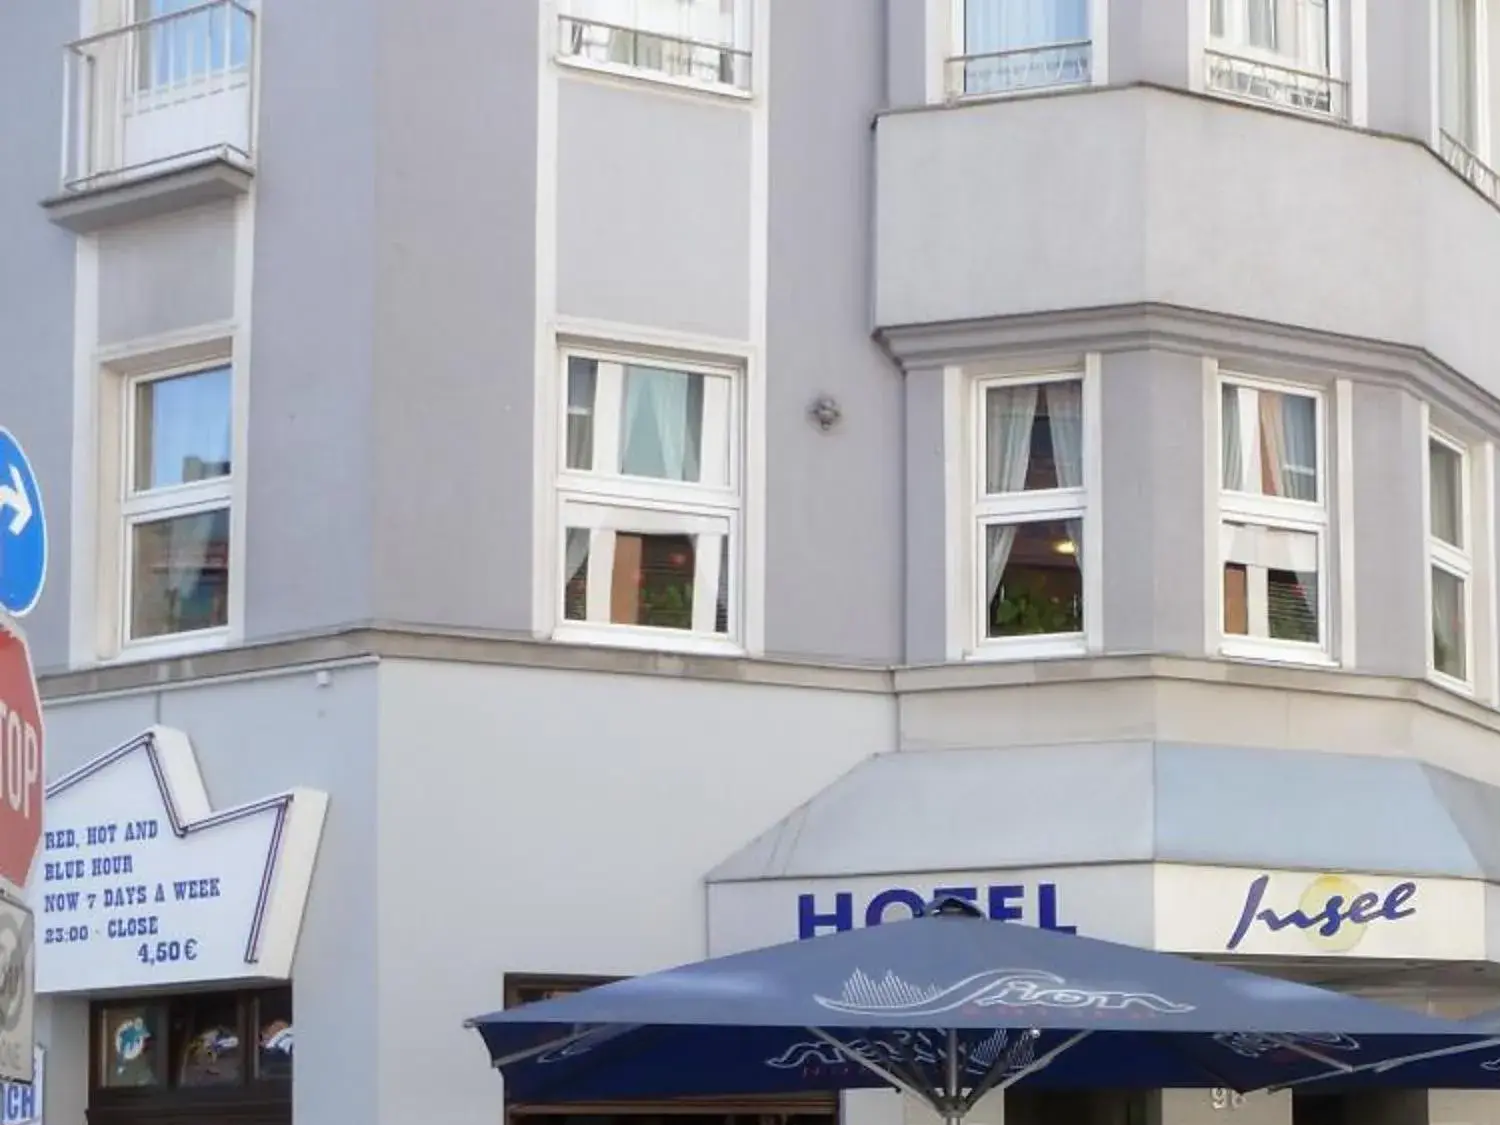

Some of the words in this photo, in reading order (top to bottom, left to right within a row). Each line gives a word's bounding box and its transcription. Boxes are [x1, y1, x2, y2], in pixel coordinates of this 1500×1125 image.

[87, 824, 117, 846] HOT
[125, 820, 158, 842] AND
[44, 860, 85, 881] BLUE
[91, 855, 133, 877] HOUR
[44, 892, 80, 913] NOW
[87, 893, 97, 909] 7
[103, 885, 148, 908] DAYS
[154, 882, 165, 902] A
[173, 878, 221, 901] WEEK
[799, 884, 1077, 940] HOEL
[1226, 874, 1416, 950] Insel
[107, 916, 159, 938] CLOSE
[8, 1085, 36, 1121] CH
